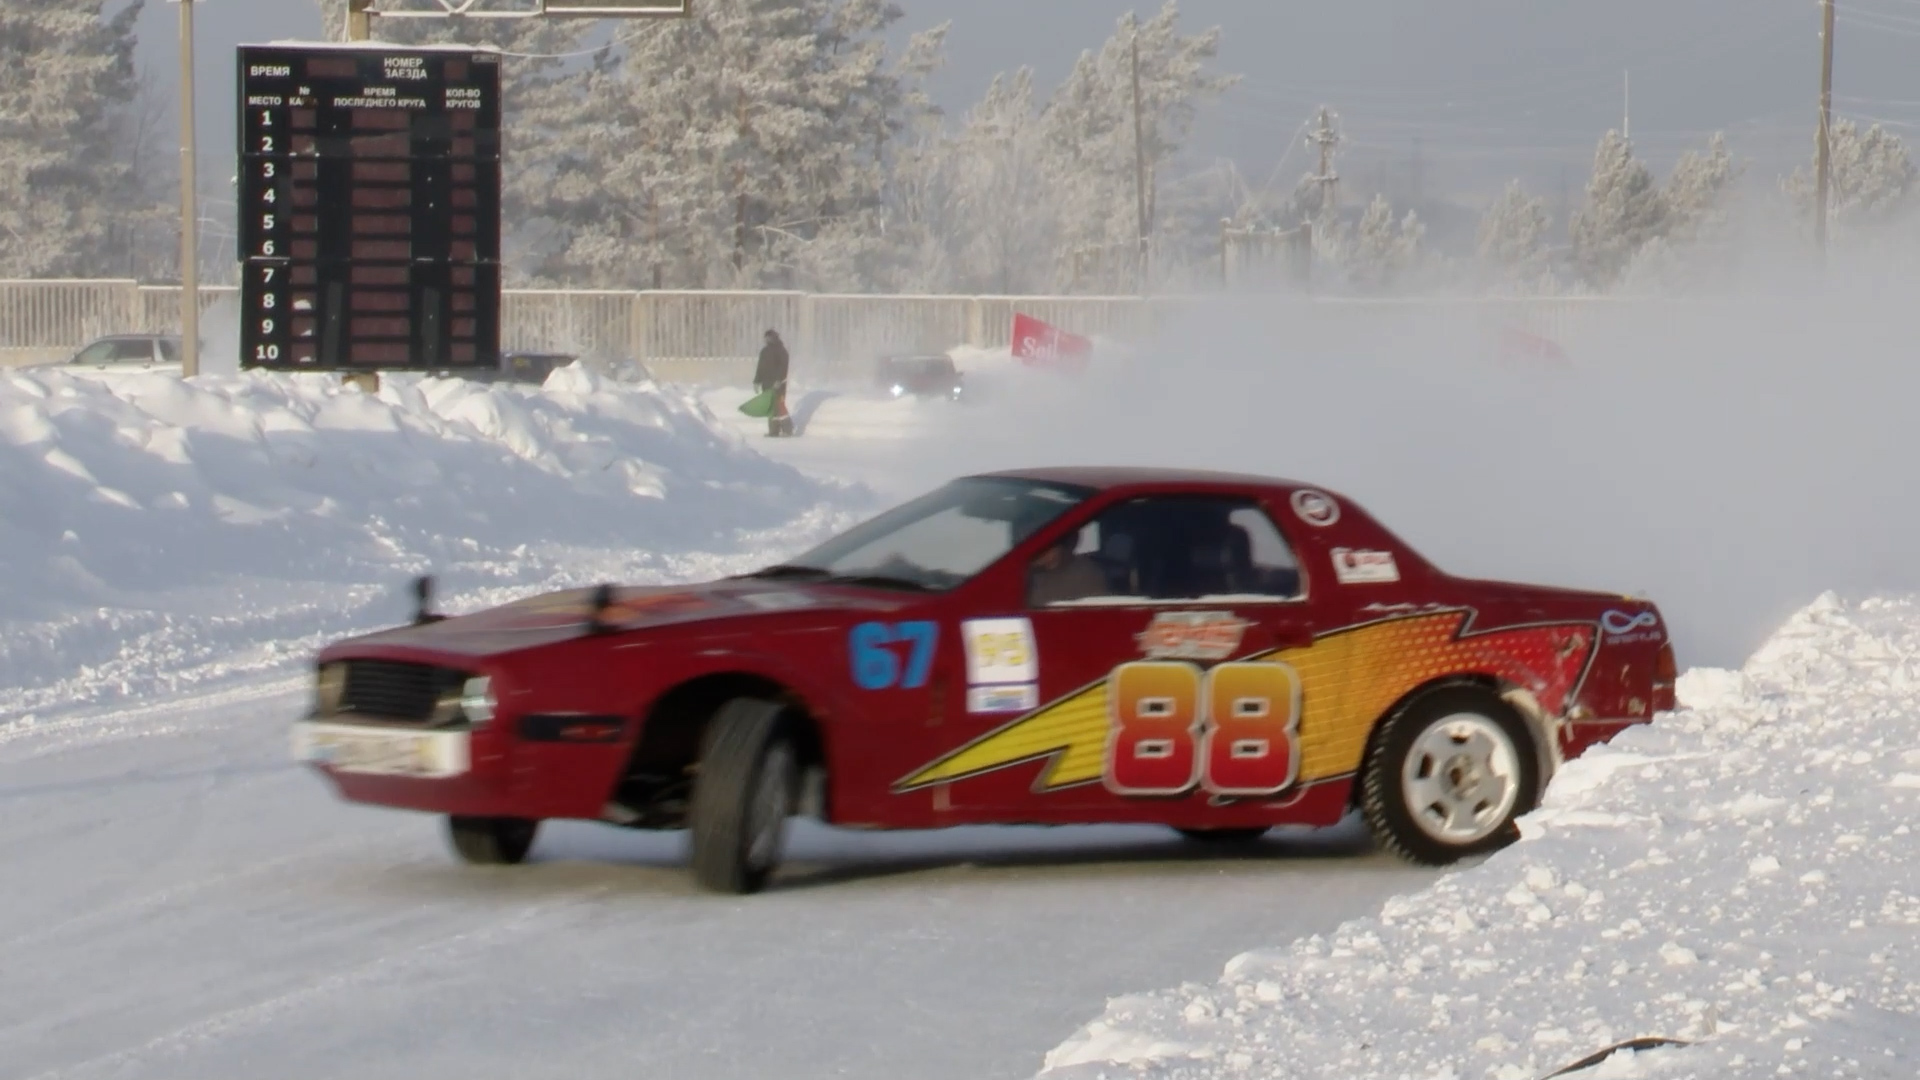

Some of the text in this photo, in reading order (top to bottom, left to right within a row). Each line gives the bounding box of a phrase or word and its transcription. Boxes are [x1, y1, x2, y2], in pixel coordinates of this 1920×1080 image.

[384, 58, 423, 68] НОМЕР
[251, 66, 291, 77] ВРЕМЯ
[384, 68, 427, 79] ЗАЕЗДА
[299, 86, 310, 96] №
[364, 88, 396, 97] ВРЕМЯ
[446, 89, 481, 98] КОЛ-ВО
[249, 97, 282, 106] МЕСТО
[334, 98, 426, 108] ПОСЛЕДНЕГО КРУГА
[446, 100, 481, 109] КРУГОВ
[262, 111, 272, 125] 1
[262, 137, 273, 151] 2
[263, 163, 275, 177] 3
[263, 189, 275, 203] 4
[263, 215, 274, 229] 5
[263, 241, 274, 254] 6
[263, 269, 274, 283] 7
[263, 294, 275, 308] 8
[262, 320, 274, 334] 9
[256, 345, 279, 359] 10
[849, 619, 938, 690] 67
[1103, 661, 1301, 796] 88
